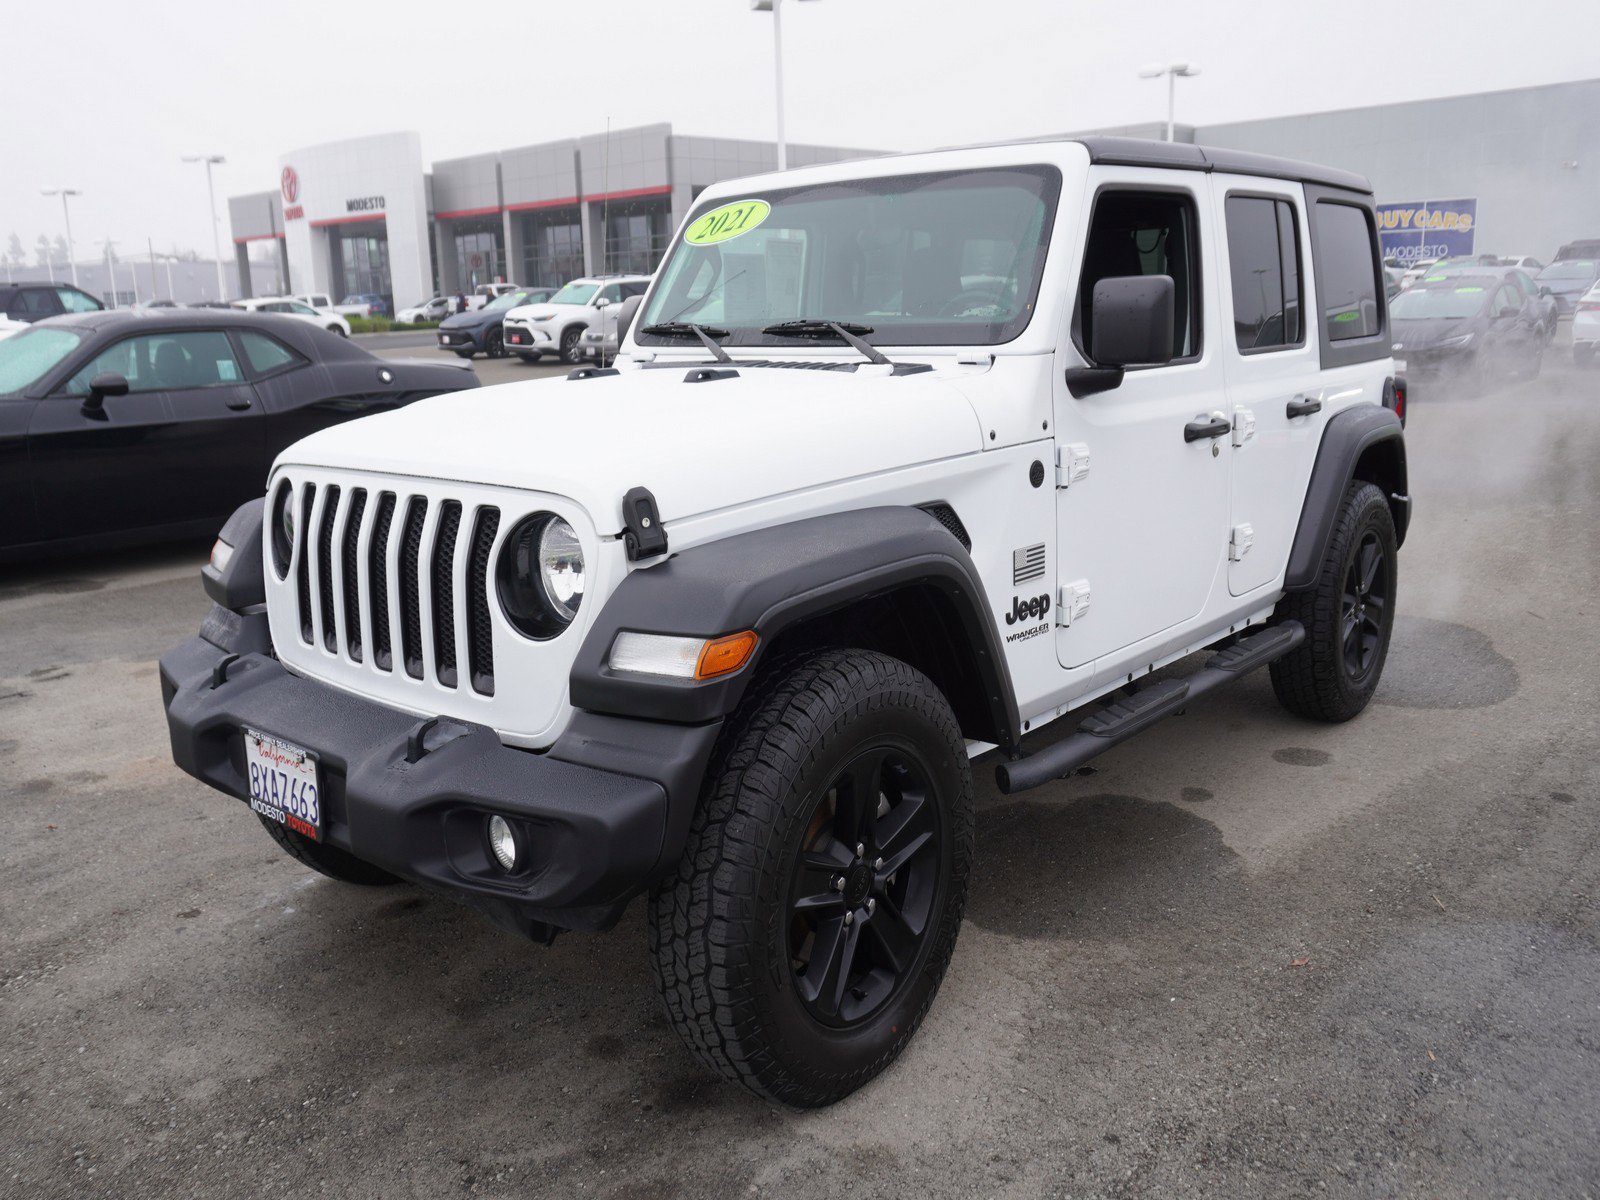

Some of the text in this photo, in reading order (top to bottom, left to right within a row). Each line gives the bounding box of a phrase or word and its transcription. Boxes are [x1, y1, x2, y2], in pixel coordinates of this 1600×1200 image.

[346, 196, 386, 212] MODESTO
[695, 204, 757, 240] 2021
[1385, 245, 1448, 258] MODESTO
[1005, 593, 1051, 626] Jeep
[1006, 623, 1049, 643] WRANGLER
[250, 797, 317, 840] MODESTO TOYOTA
